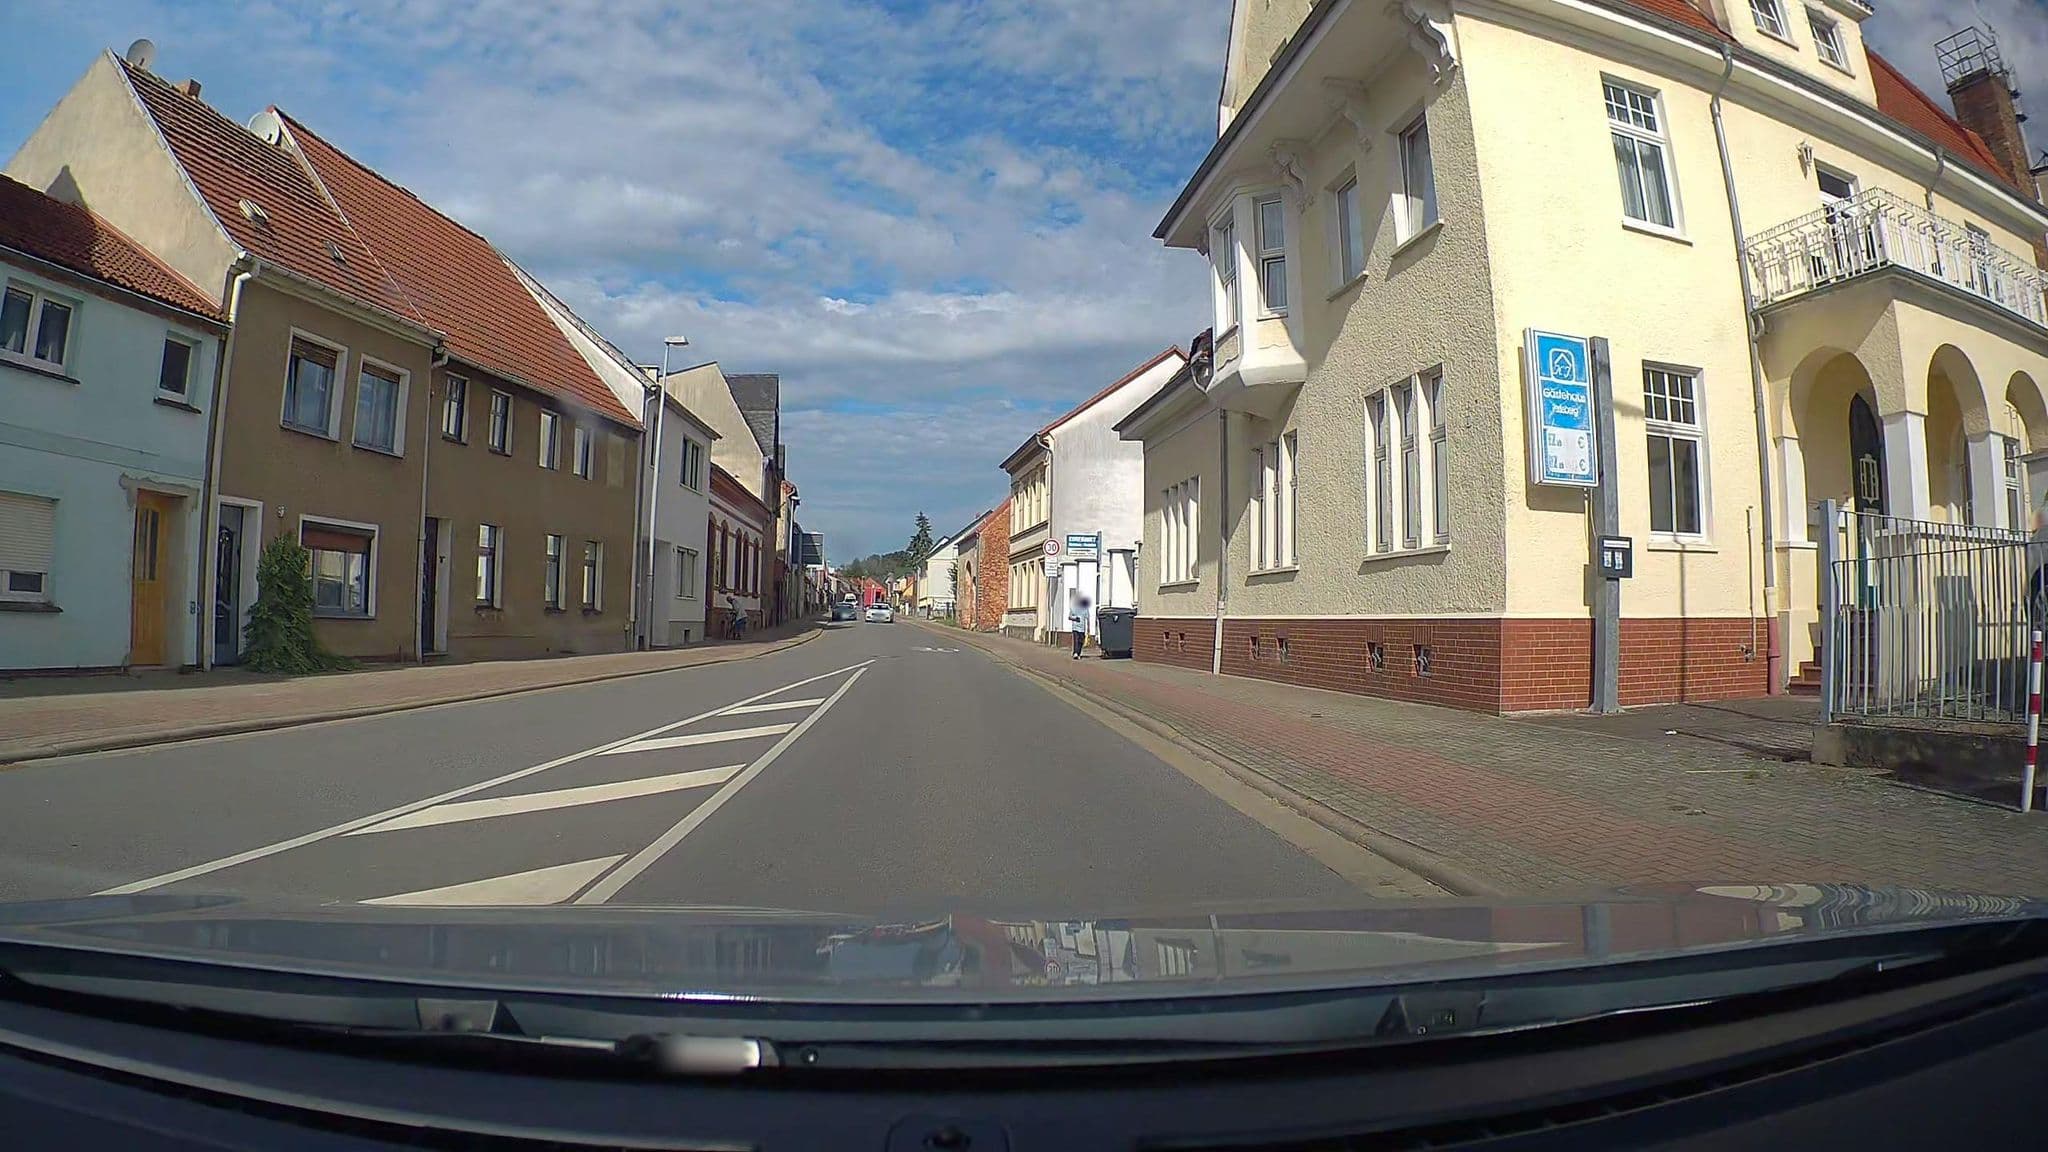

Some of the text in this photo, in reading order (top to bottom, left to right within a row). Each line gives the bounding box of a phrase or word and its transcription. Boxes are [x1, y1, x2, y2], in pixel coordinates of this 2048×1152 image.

[1543, 388, 1586, 403] Gästehaus
[1577, 436, 1585, 449] €
[1579, 458, 1586, 472] €
